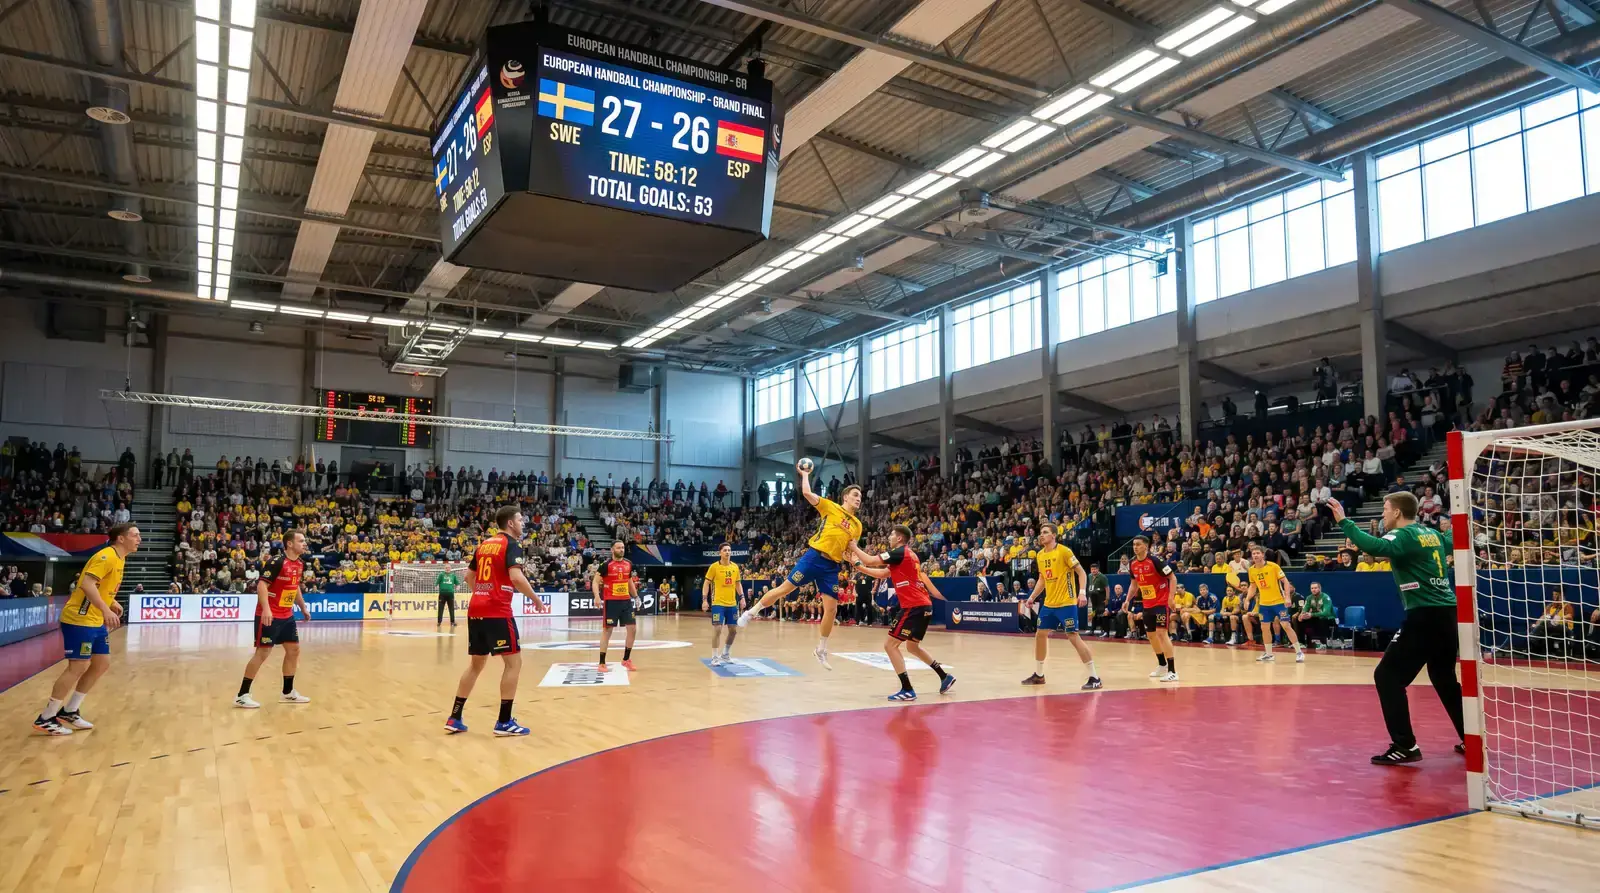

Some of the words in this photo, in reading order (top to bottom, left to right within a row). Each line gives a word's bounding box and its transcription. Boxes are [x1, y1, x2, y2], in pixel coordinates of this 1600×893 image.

[567, 33, 616, 57] EUROPEAN
[617, 46, 665, 70] HANDBALL
[665, 59, 729, 85] CHAMPIONSHIP
[543, 54, 592, 77] EUROPEAN
[594, 67, 641, 89] HANDBALL
[642, 78, 706, 104] CHAMPIONSHIP
[712, 95, 740, 113] GRAND
[741, 101, 765, 119] FINAL
[550, 122, 582, 145] SWE
[601, 95, 642, 139] 27
[650, 121, 663, 130] -
[671, 111, 710, 155] 26
[446, 139, 458, 185] 27
[463, 113, 477, 161] 26
[608, 150, 650, 178] TIME:
[654, 160, 698, 188] 58:12
[727, 159, 751, 179] ESP
[588, 174, 636, 203] TOTAL
[639, 184, 690, 213] GOALS:
[694, 195, 713, 217] 53
[478, 556, 492, 581] 16
[1432, 549, 1443, 577] 1
[142, 597, 180, 609] LIQUI
[142, 608, 180, 619] MOLY
[202, 608, 239, 618] MOLY
[203, 597, 239, 609] LIQUI
